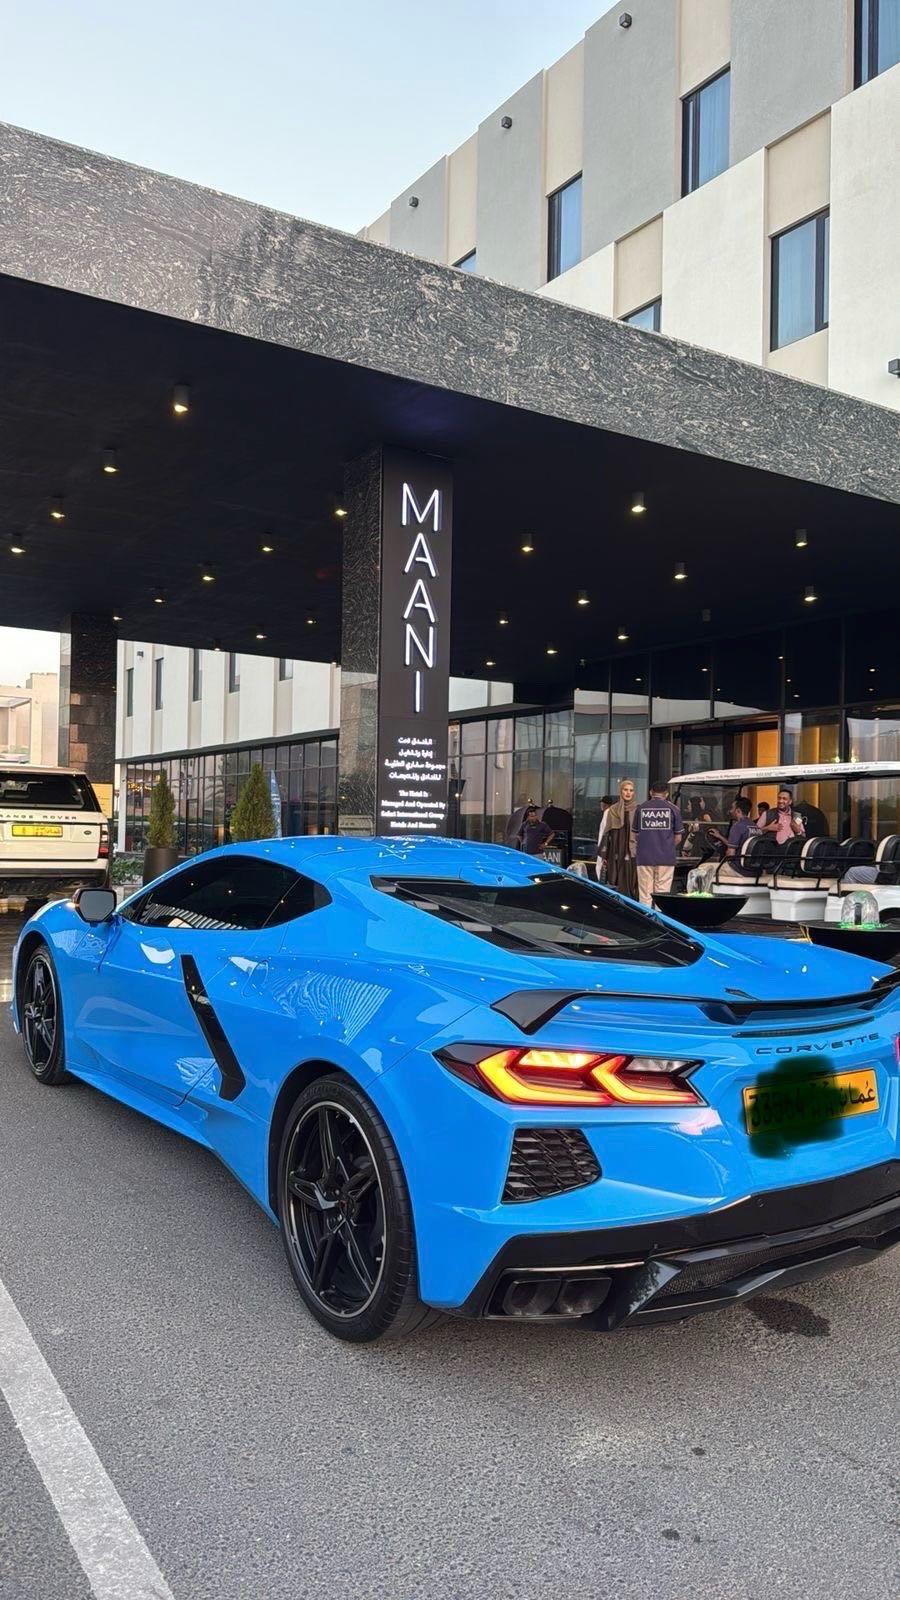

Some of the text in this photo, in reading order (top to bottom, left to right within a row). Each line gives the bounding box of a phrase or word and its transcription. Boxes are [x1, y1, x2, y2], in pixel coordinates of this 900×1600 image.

[401, 482, 440, 713] MAANI
[381, 799, 404, 808] Managed
[416, 801, 439, 809] Operated
[407, 821, 418, 829] And
[645, 820, 667, 828] Valet
[543, 850, 561, 864] AANI
[756, 1032, 880, 1055] CORVETTE
